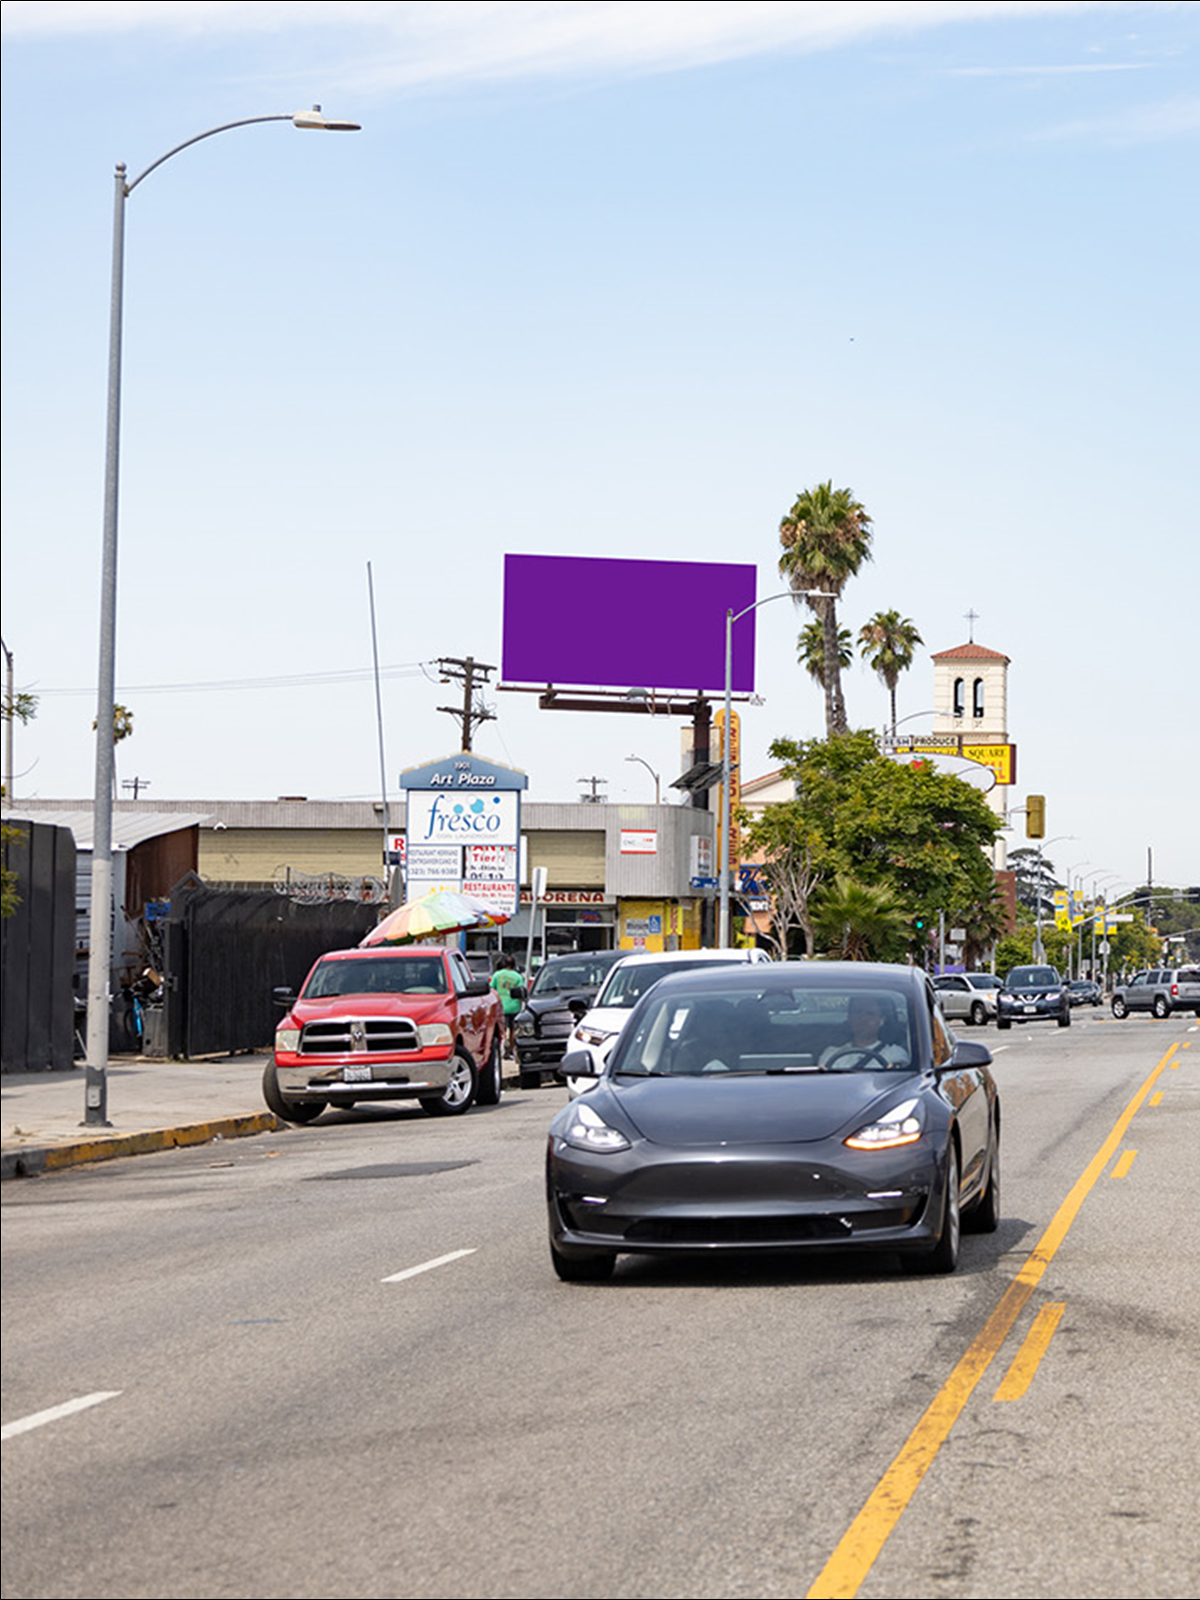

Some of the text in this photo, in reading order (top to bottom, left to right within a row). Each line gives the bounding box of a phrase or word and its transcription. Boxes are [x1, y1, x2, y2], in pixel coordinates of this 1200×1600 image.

[914, 737, 956, 745] PRODUCE
[968, 748, 1006, 759] SQUARE
[430, 773, 496, 785] Art Plaza
[424, 794, 501, 840] fresco
[463, 883, 516, 892] RESTAURANTE
